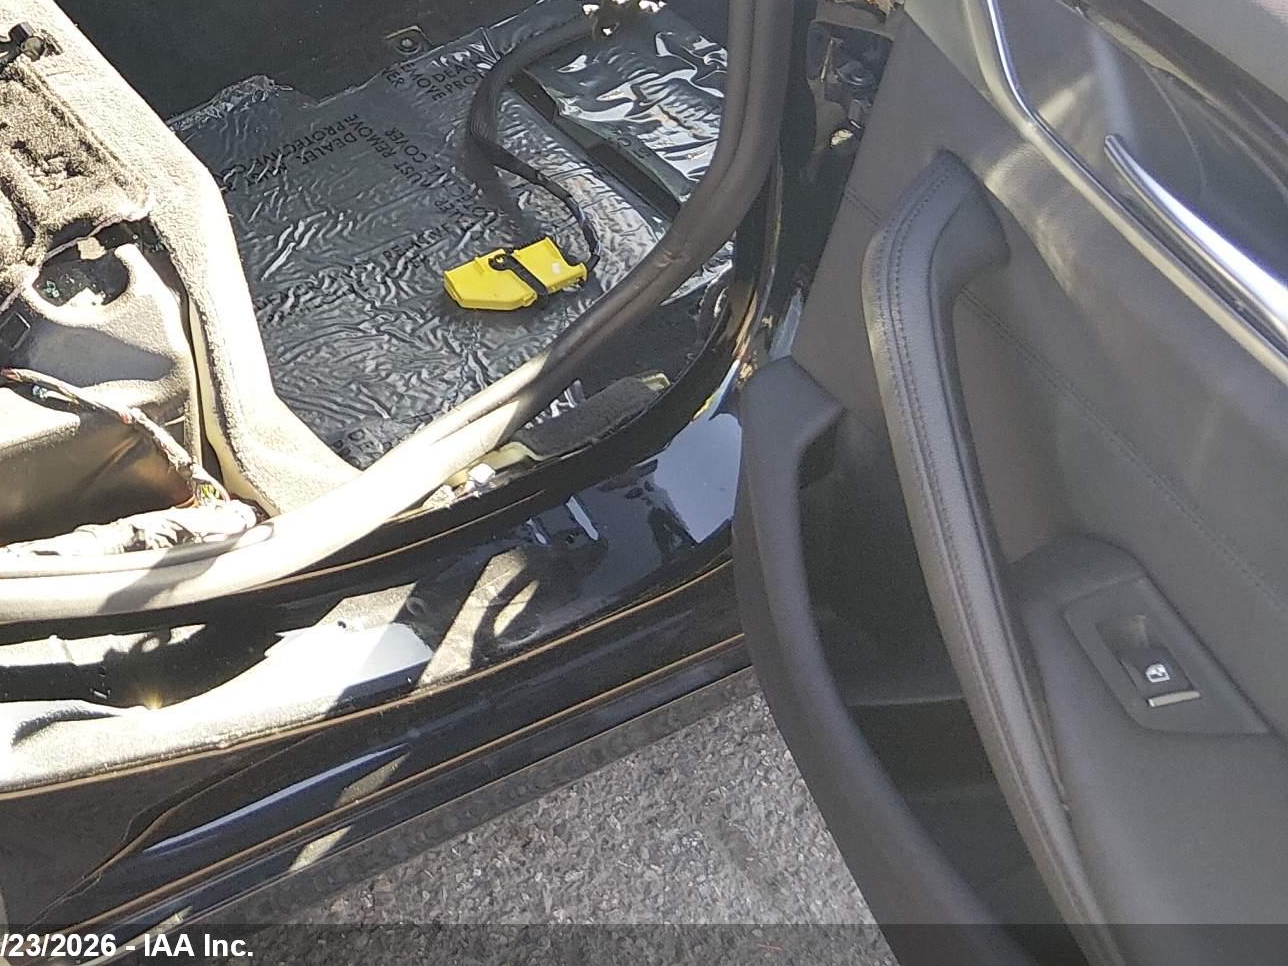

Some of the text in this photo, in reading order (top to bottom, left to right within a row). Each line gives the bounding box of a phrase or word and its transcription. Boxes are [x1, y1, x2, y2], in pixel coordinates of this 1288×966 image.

[399, 62, 446, 101] EMOVE
[295, 131, 358, 165] DEALER
[343, 113, 397, 159] REMOVE
[384, 126, 428, 164] COVER
